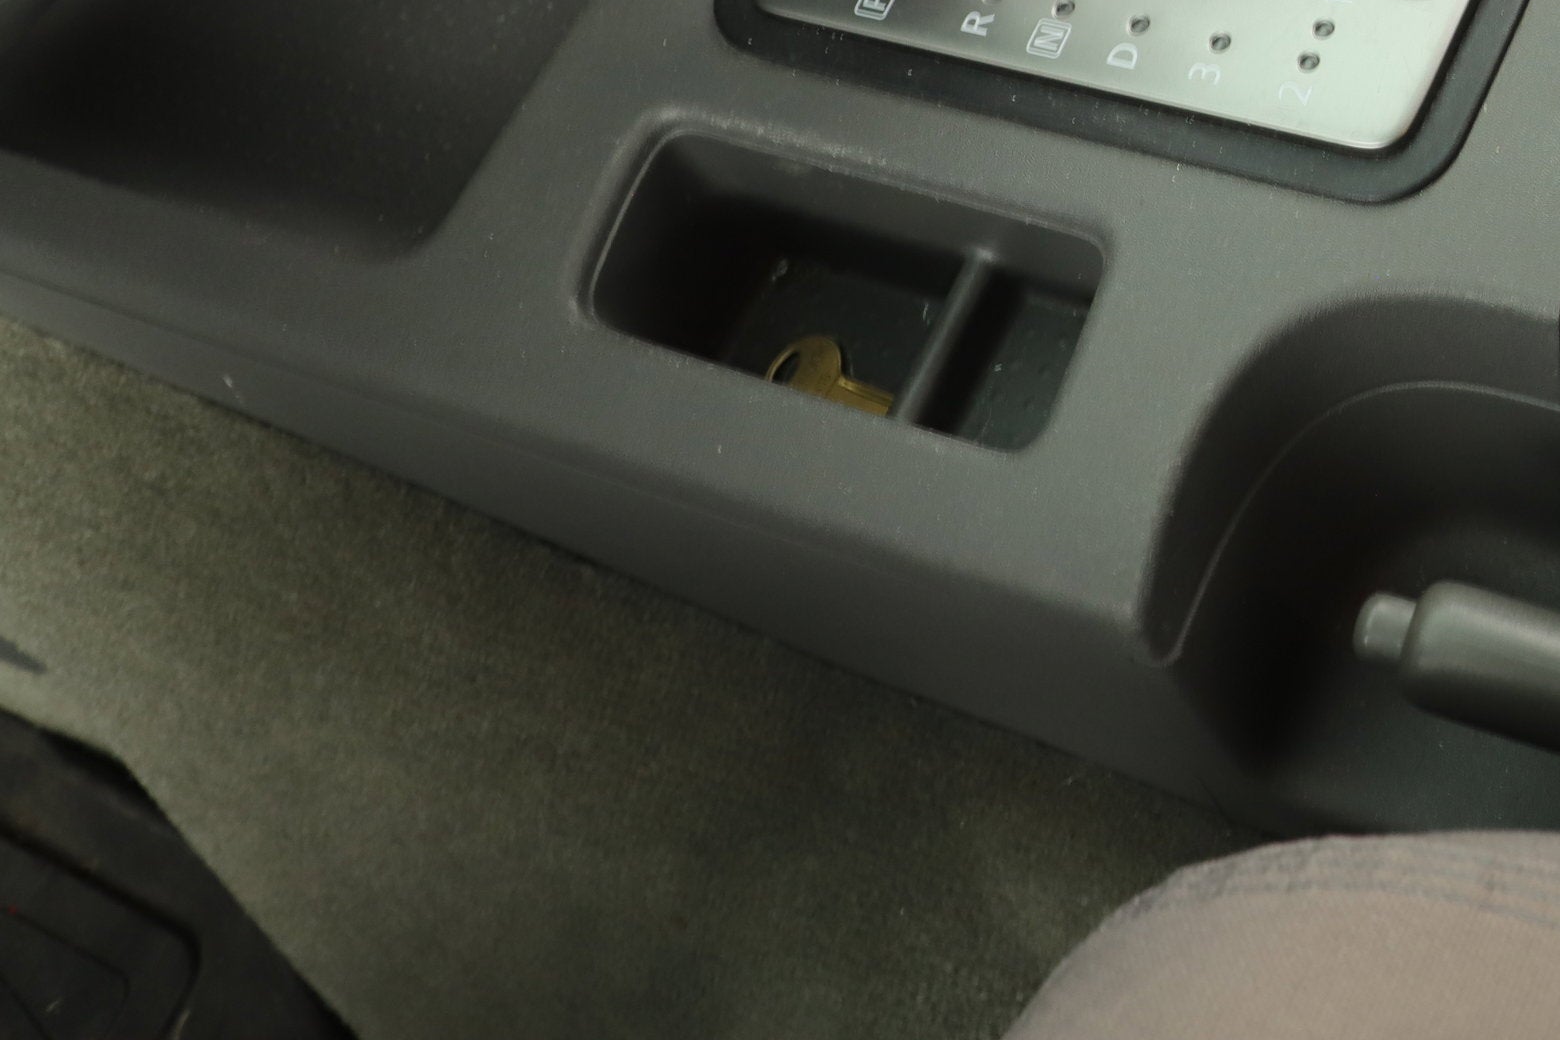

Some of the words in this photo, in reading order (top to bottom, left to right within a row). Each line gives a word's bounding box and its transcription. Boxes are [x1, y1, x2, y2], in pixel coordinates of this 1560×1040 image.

[960, 11, 996, 36] R
[1033, 25, 1064, 52] N
[1107, 43, 1138, 70] D
[1188, 63, 1220, 85] 3
[1278, 81, 1313, 106] 2
